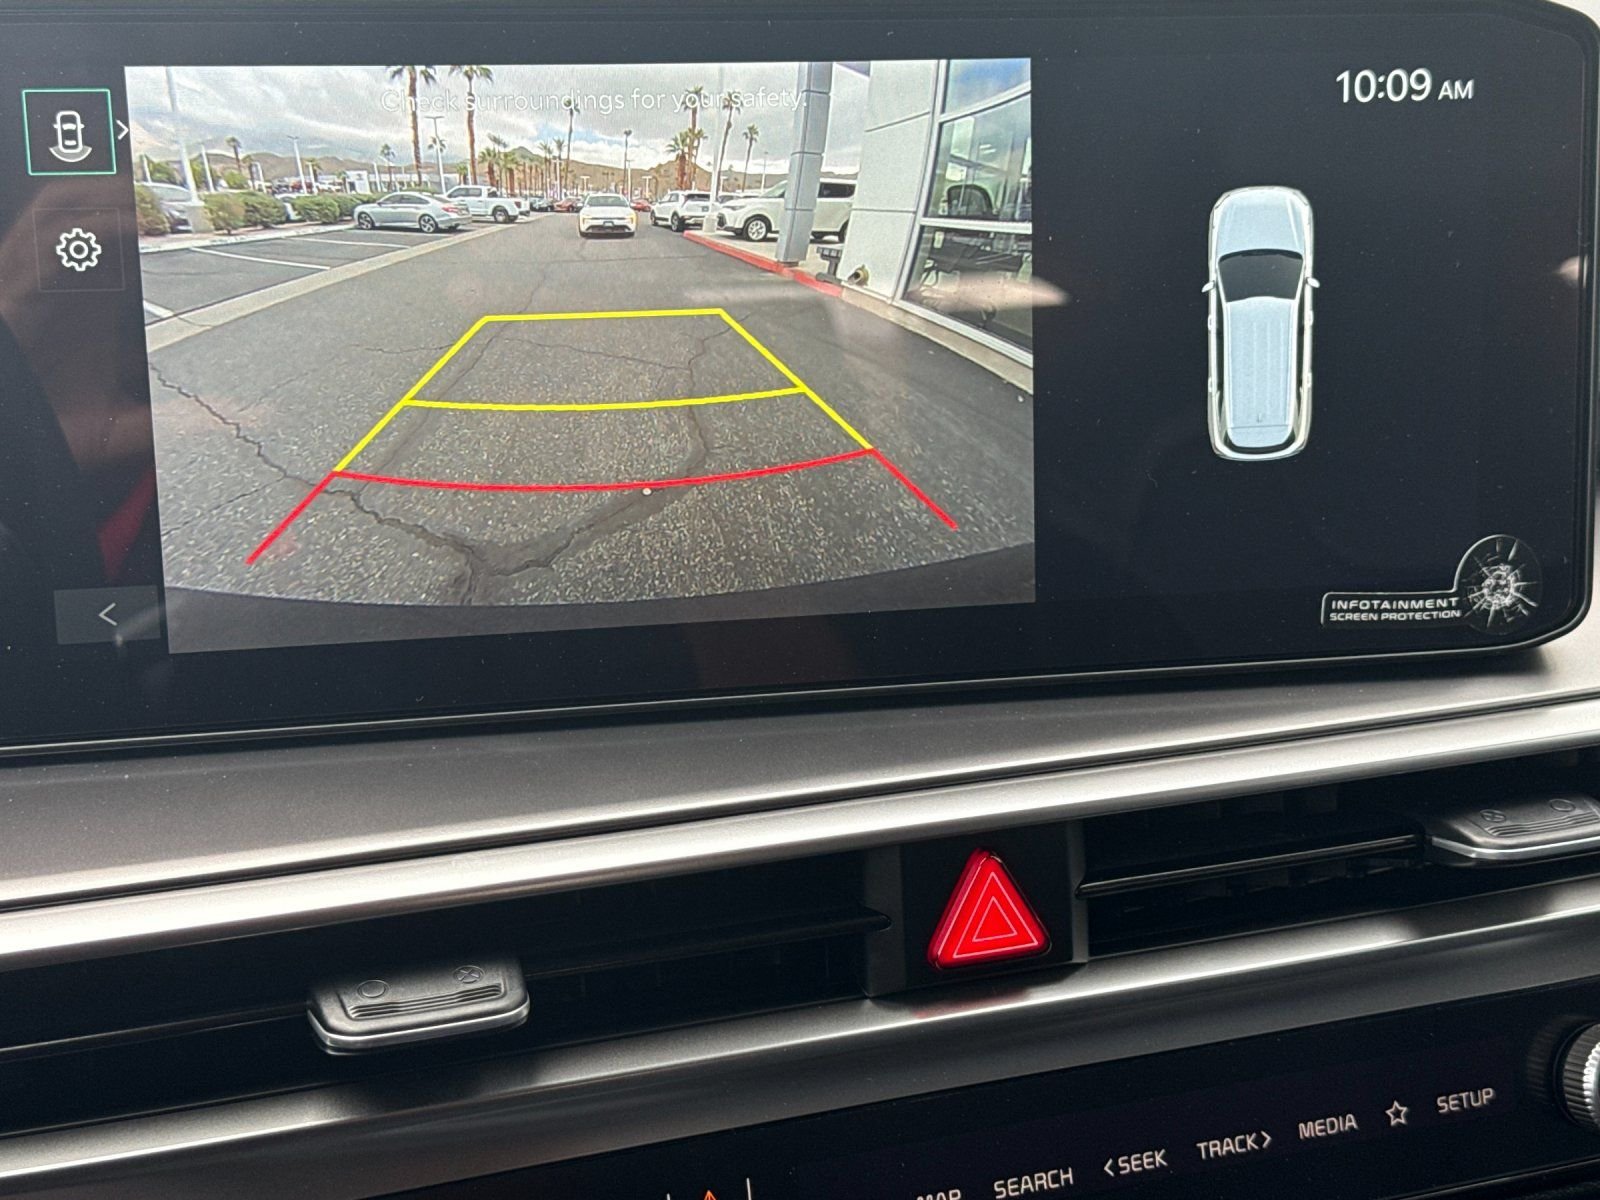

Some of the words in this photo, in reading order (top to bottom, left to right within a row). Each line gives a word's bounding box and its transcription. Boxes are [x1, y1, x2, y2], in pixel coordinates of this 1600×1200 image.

[1336, 68, 1432, 103] 10:09
[1438, 79, 1474, 101] AM
[380, 88, 456, 113] Check
[465, 87, 625, 115] surroundings
[630, 86, 664, 111] for
[671, 86, 728, 114] your
[732, 85, 808, 112] safety.
[1329, 611, 1377, 621] SCREEN
[1380, 610, 1462, 621] PROTECTION
[1331, 597, 1460, 610] INFOTAINMENT
[1436, 1087, 1495, 1113] SETUP
[1298, 1112, 1358, 1139] MEDIA
[916, 1189, 962, 1200] AP
[993, 1167, 1074, 1200] SEARCH
